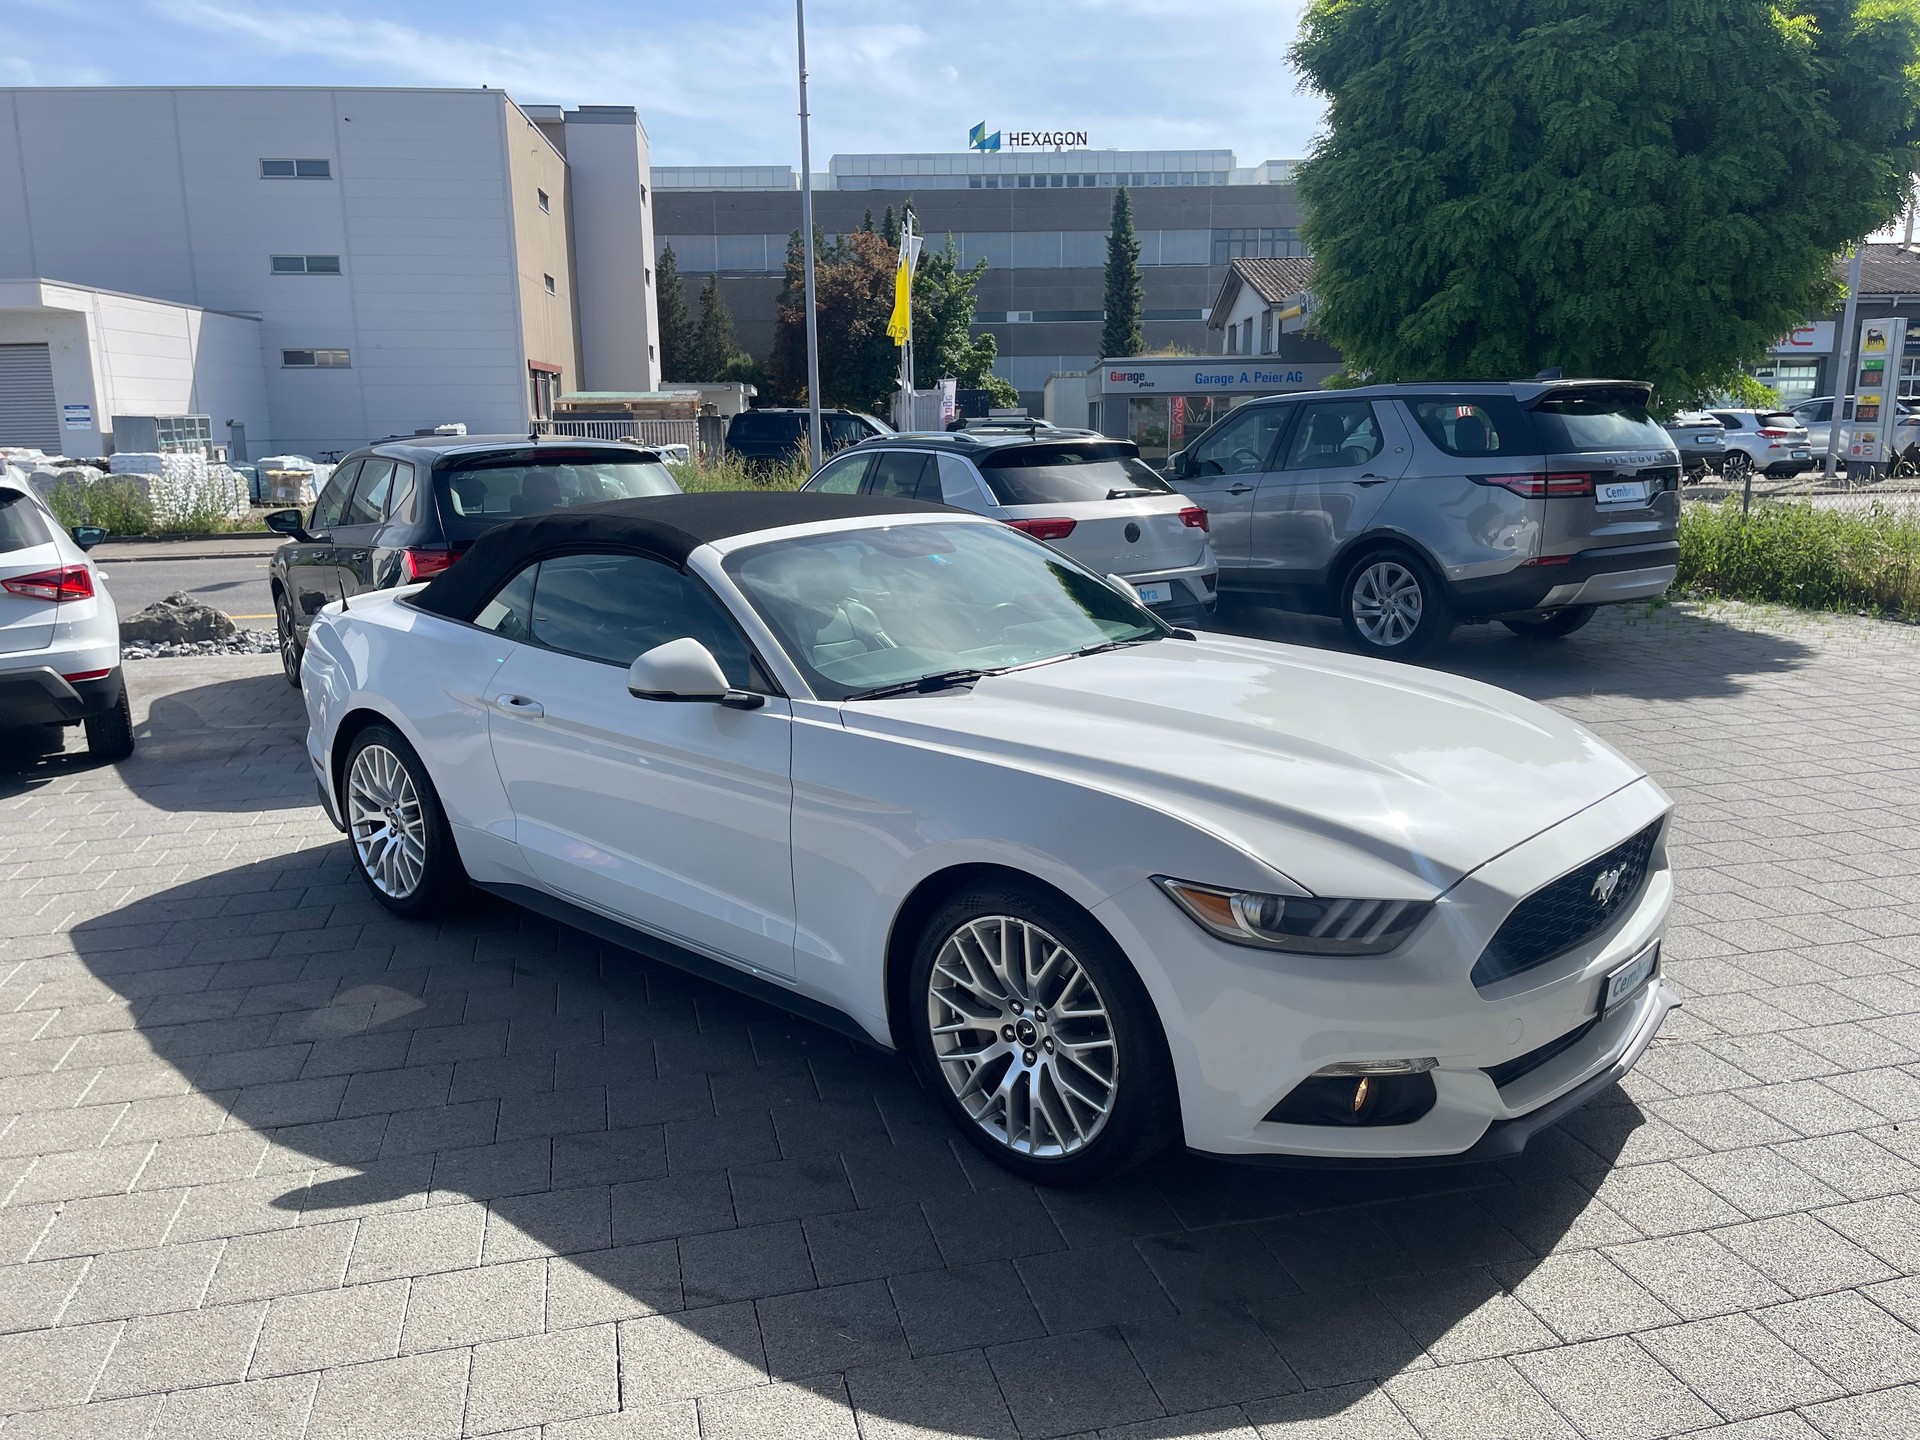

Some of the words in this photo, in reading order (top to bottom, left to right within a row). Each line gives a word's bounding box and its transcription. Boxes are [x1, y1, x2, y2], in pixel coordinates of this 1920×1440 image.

[1009, 131, 1087, 146] HEXAGON
[1110, 371, 1145, 384] Garage
[1195, 372, 1234, 386] Garage
[1239, 372, 1251, 383] A.
[1254, 371, 1283, 383] Peier
[1286, 371, 1303, 383] AG
[1605, 485, 1637, 498] Cembra
[1139, 587, 1159, 601] bra
